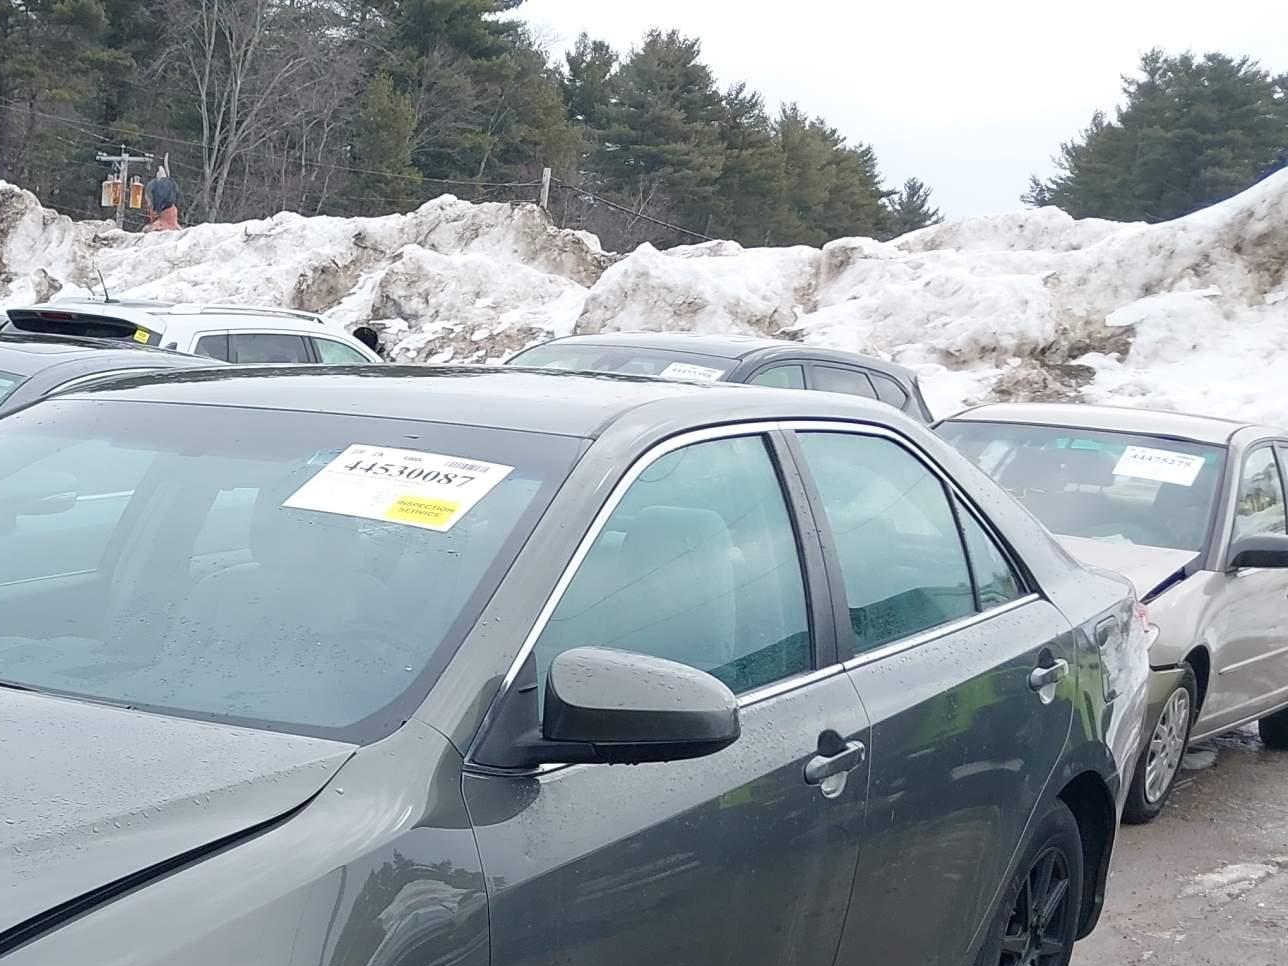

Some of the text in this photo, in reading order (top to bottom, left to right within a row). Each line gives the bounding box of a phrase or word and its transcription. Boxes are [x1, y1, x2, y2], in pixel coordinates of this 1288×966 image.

[344, 459, 476, 488] 44530087
[396, 500, 456, 513] INSPECTION
[398, 508, 441, 518] SERVICE
